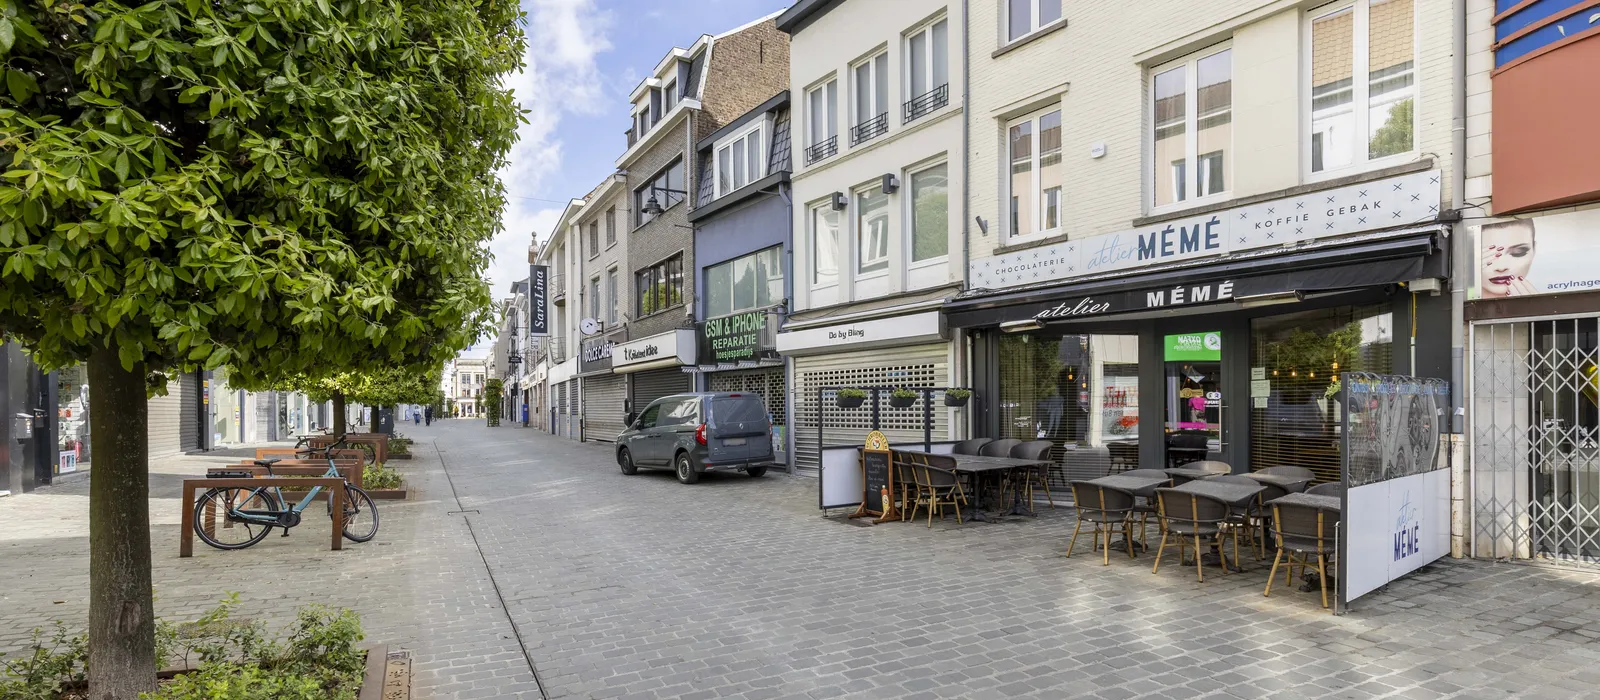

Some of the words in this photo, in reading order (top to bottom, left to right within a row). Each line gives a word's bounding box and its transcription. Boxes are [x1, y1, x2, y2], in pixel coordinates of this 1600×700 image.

[1255, 213, 1309, 229] KOFFIE
[1326, 201, 1381, 217] GEBAK
[1087, 234, 1142, 270] atelier
[1138, 216, 1220, 260] MÉMÉ
[995, 258, 1065, 275] CHOCOLATERIE
[534, 270, 545, 329] SaraLina
[1032, 296, 1110, 319] atelier
[1147, 280, 1234, 308] MÉMÉ
[705, 318, 723, 338] GSM
[724, 317, 731, 335] &
[732, 310, 766, 334] IPHONE
[838, 330, 847, 340] by
[848, 325, 865, 338] Bling
[712, 333, 757, 350] REPARATIE
[1394, 520, 1419, 562] MÉMÉ
